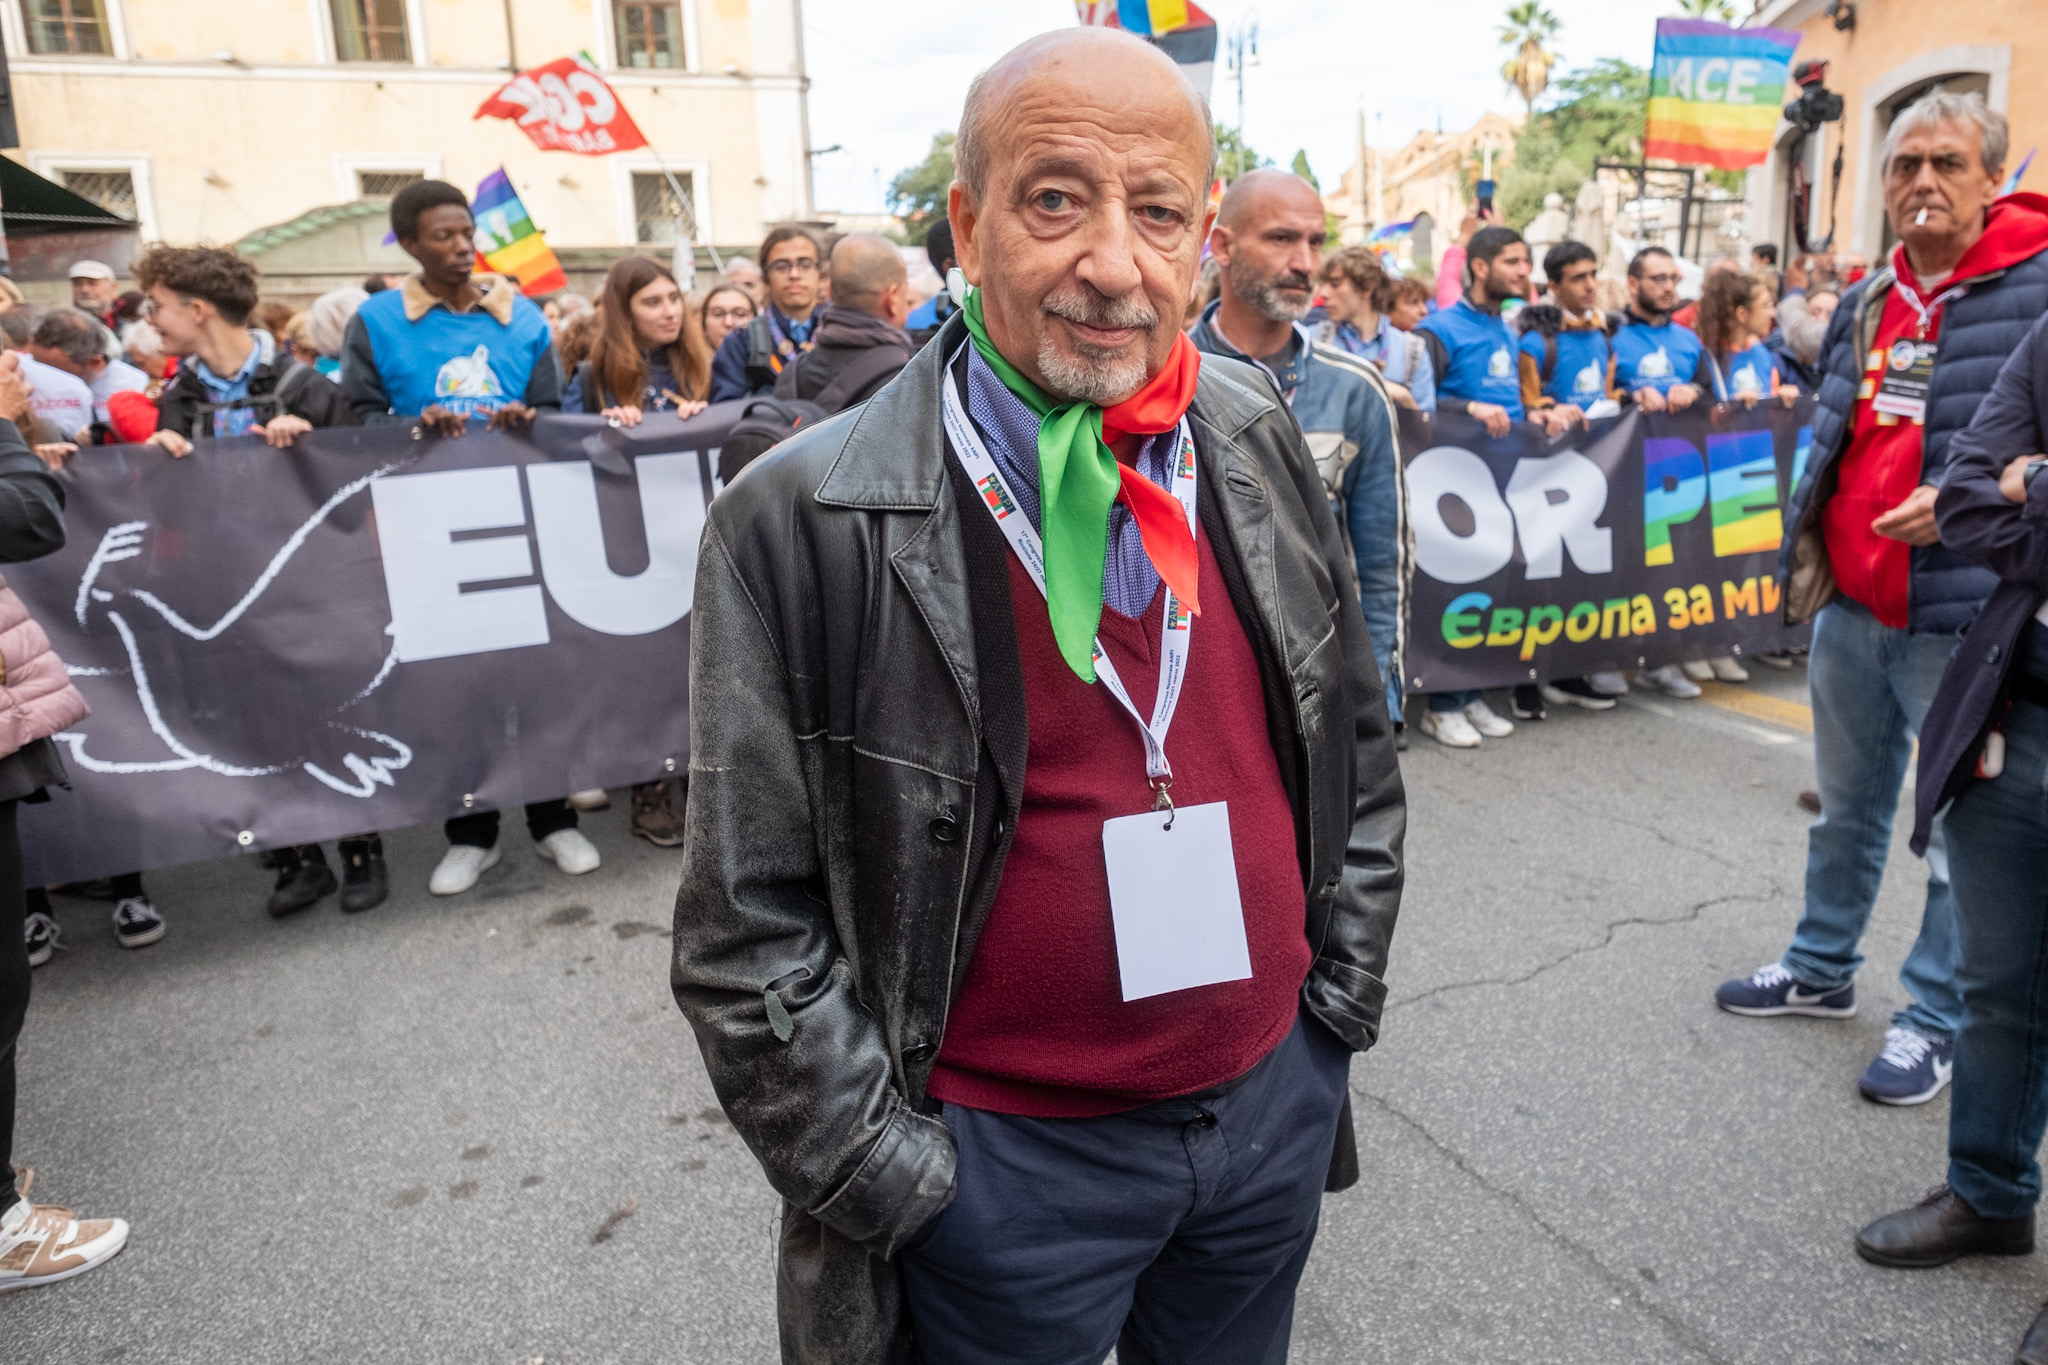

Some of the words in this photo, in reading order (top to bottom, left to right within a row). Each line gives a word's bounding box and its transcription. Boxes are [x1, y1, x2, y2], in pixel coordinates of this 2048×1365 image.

[370, 447, 725, 664] EU
[1403, 446, 1614, 585] OR
[1017, 538, 1033, 561] Riccione
[1031, 560, 1042, 574] 24/27
[1441, 591, 1658, 662] Європа
[1663, 583, 1715, 631] за
[1166, 664, 1174, 690] Nazionale
